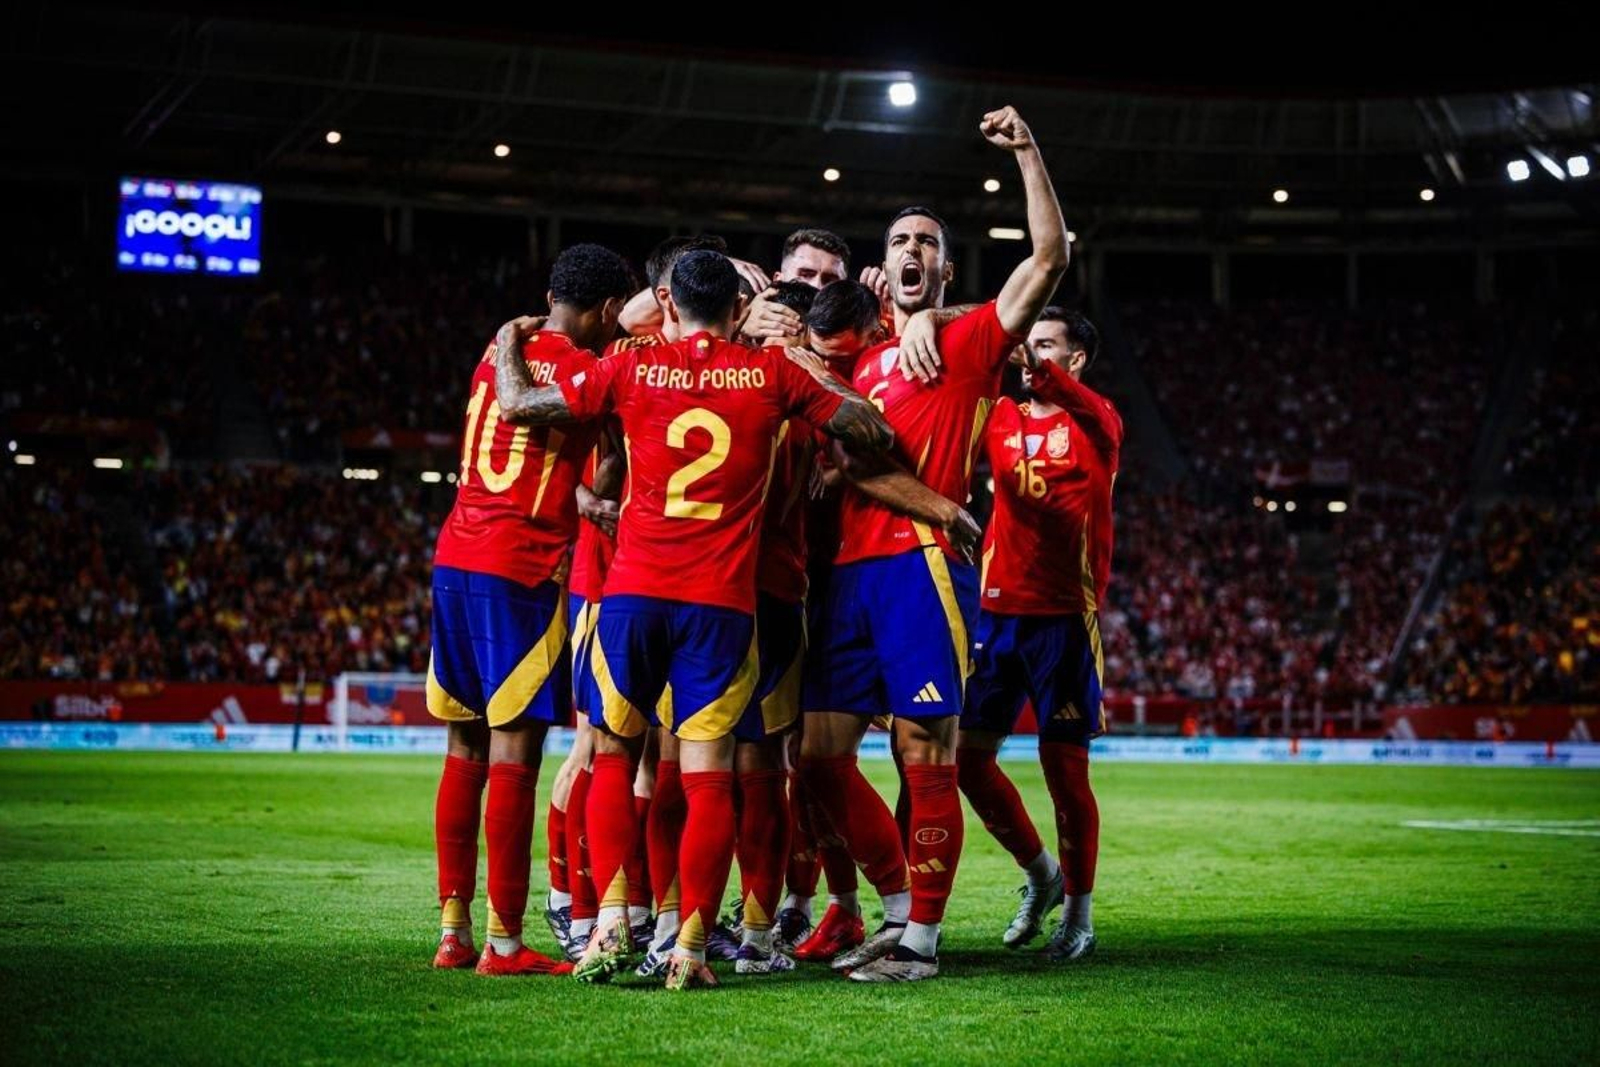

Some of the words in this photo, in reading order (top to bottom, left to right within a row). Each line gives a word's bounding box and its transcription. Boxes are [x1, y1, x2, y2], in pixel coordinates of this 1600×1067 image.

[635, 363, 693, 389] PEDRO
[699, 366, 765, 390] PORRO
[461, 381, 530, 493] 10
[664, 407, 731, 521] 2
[1014, 459, 1047, 499] 16
